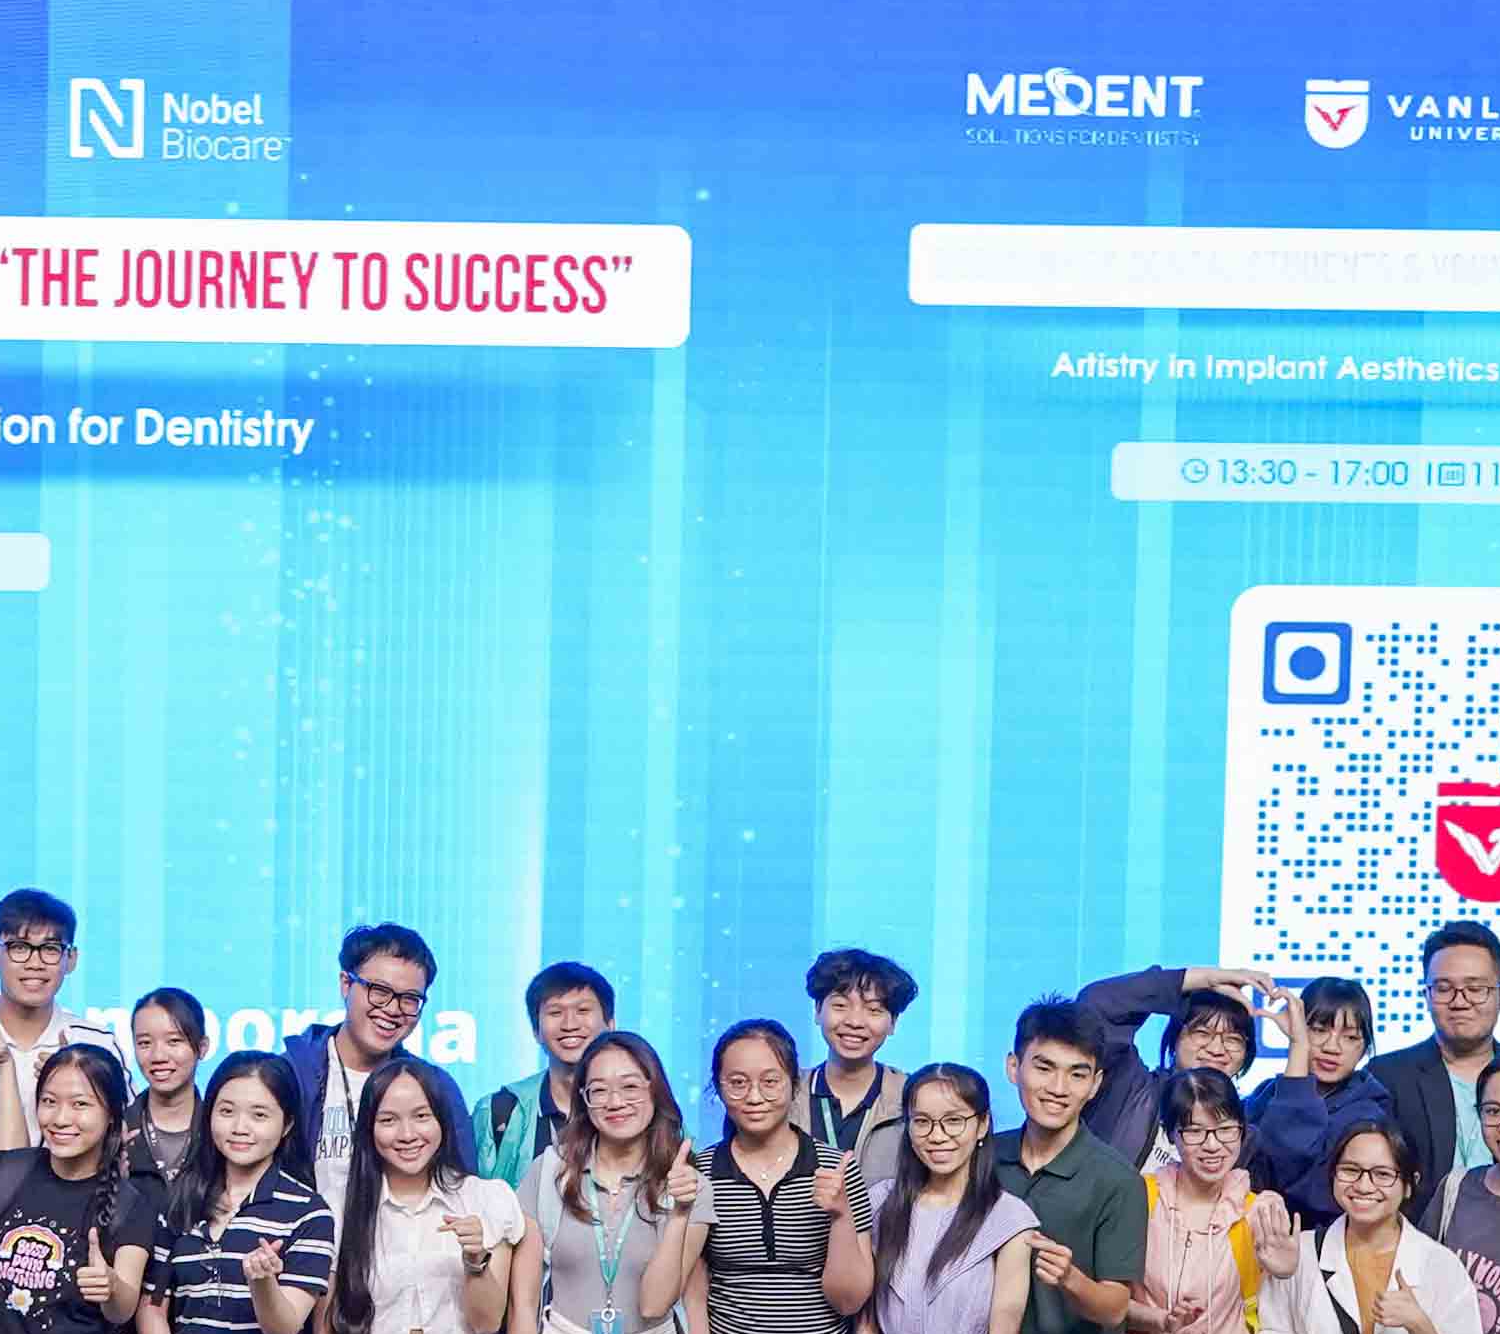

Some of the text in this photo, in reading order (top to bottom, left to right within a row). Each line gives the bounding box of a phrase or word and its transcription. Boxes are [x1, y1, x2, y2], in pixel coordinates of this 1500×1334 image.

[164, 92, 263, 124] Nobel
[967, 68, 1203, 117] MEDENT
[163, 128, 283, 160] Biocare
[115, 250, 318, 309] JOURNEY
[333, 252, 387, 310] TO
[405, 253, 632, 313] SUCCESS”
[1052, 352, 1159, 383] Artistry
[1169, 354, 1195, 378] in
[1207, 355, 1328, 384] Implant
[69, 408, 123, 444] for
[136, 409, 314, 454] Dentistry
[1217, 459, 1296, 484] 13:30
[1330, 460, 1408, 487] 17:00
[16, 1239, 50, 1259] BUSY
